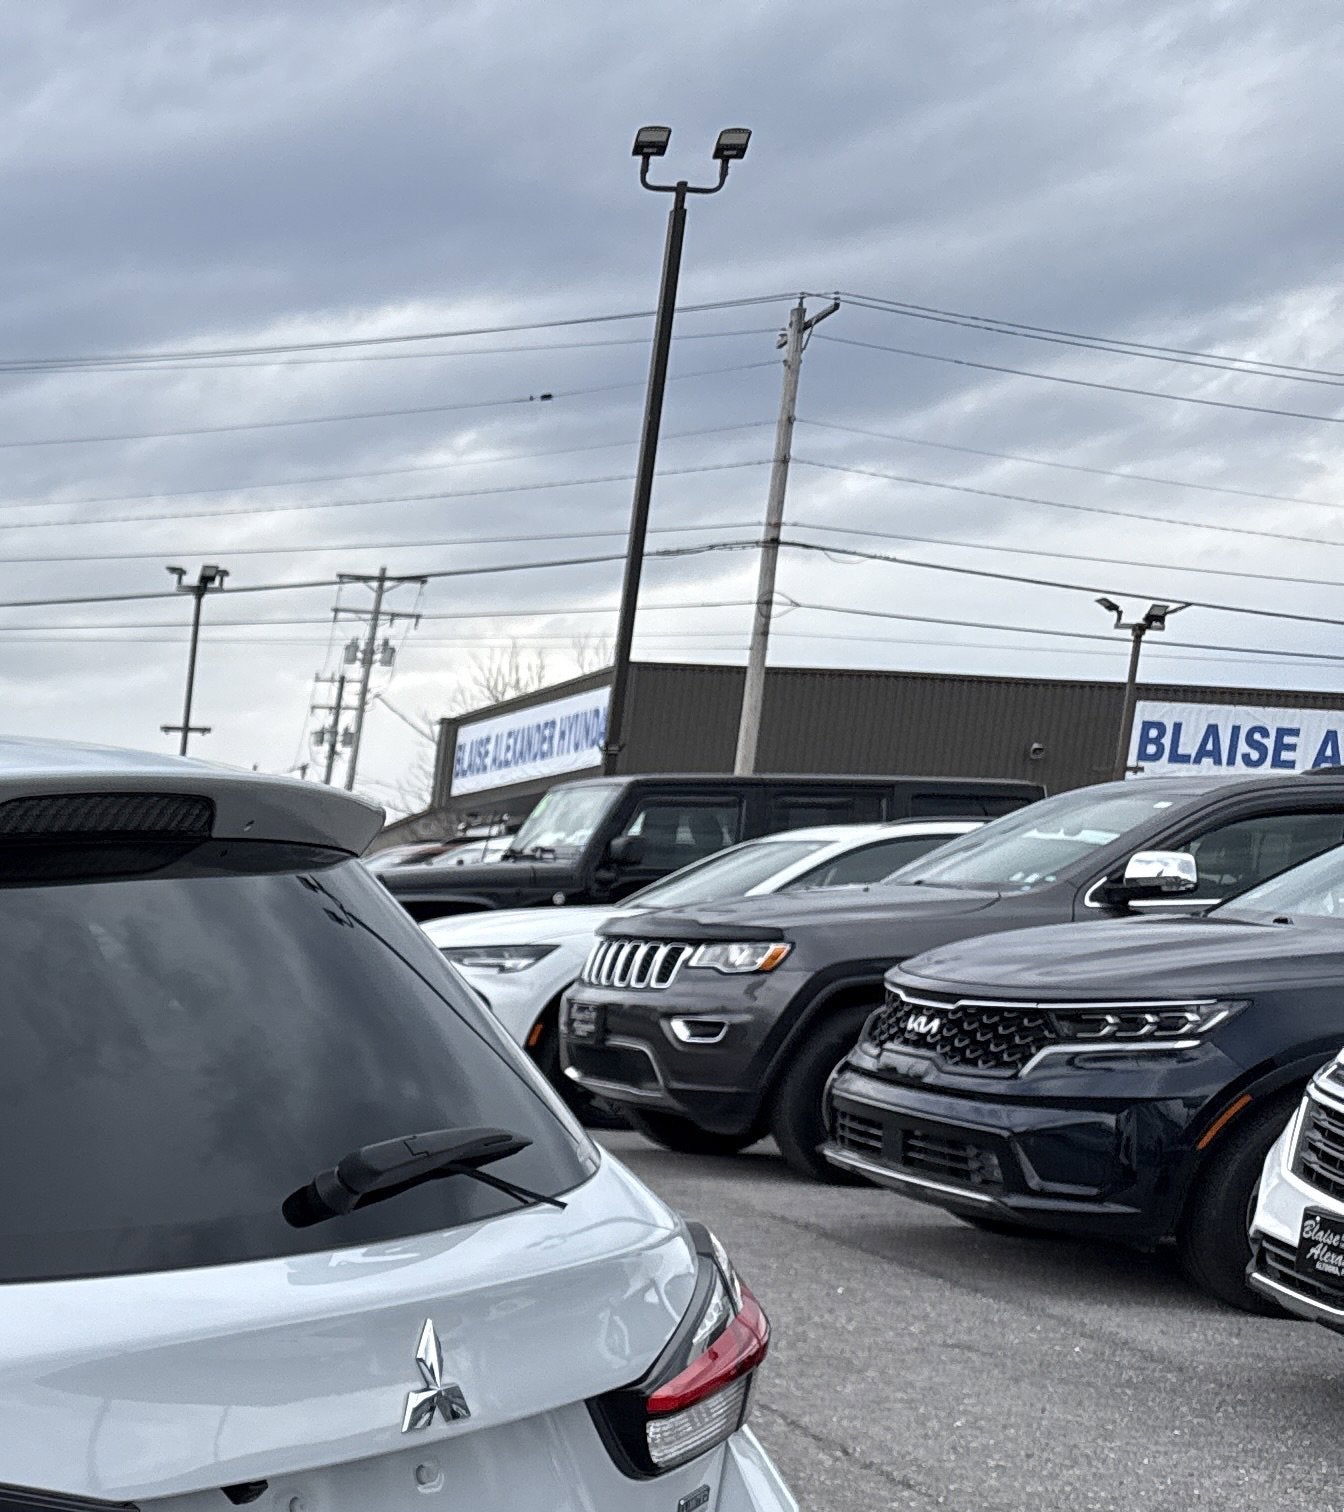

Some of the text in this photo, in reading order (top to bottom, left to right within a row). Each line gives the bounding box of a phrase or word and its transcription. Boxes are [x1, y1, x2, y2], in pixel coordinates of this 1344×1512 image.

[454, 706, 609, 779] BLAISE ALEXANDER HYUNDA
[1136, 719, 1301, 770] BLAISE
[1305, 1242, 1344, 1267] Alexa
